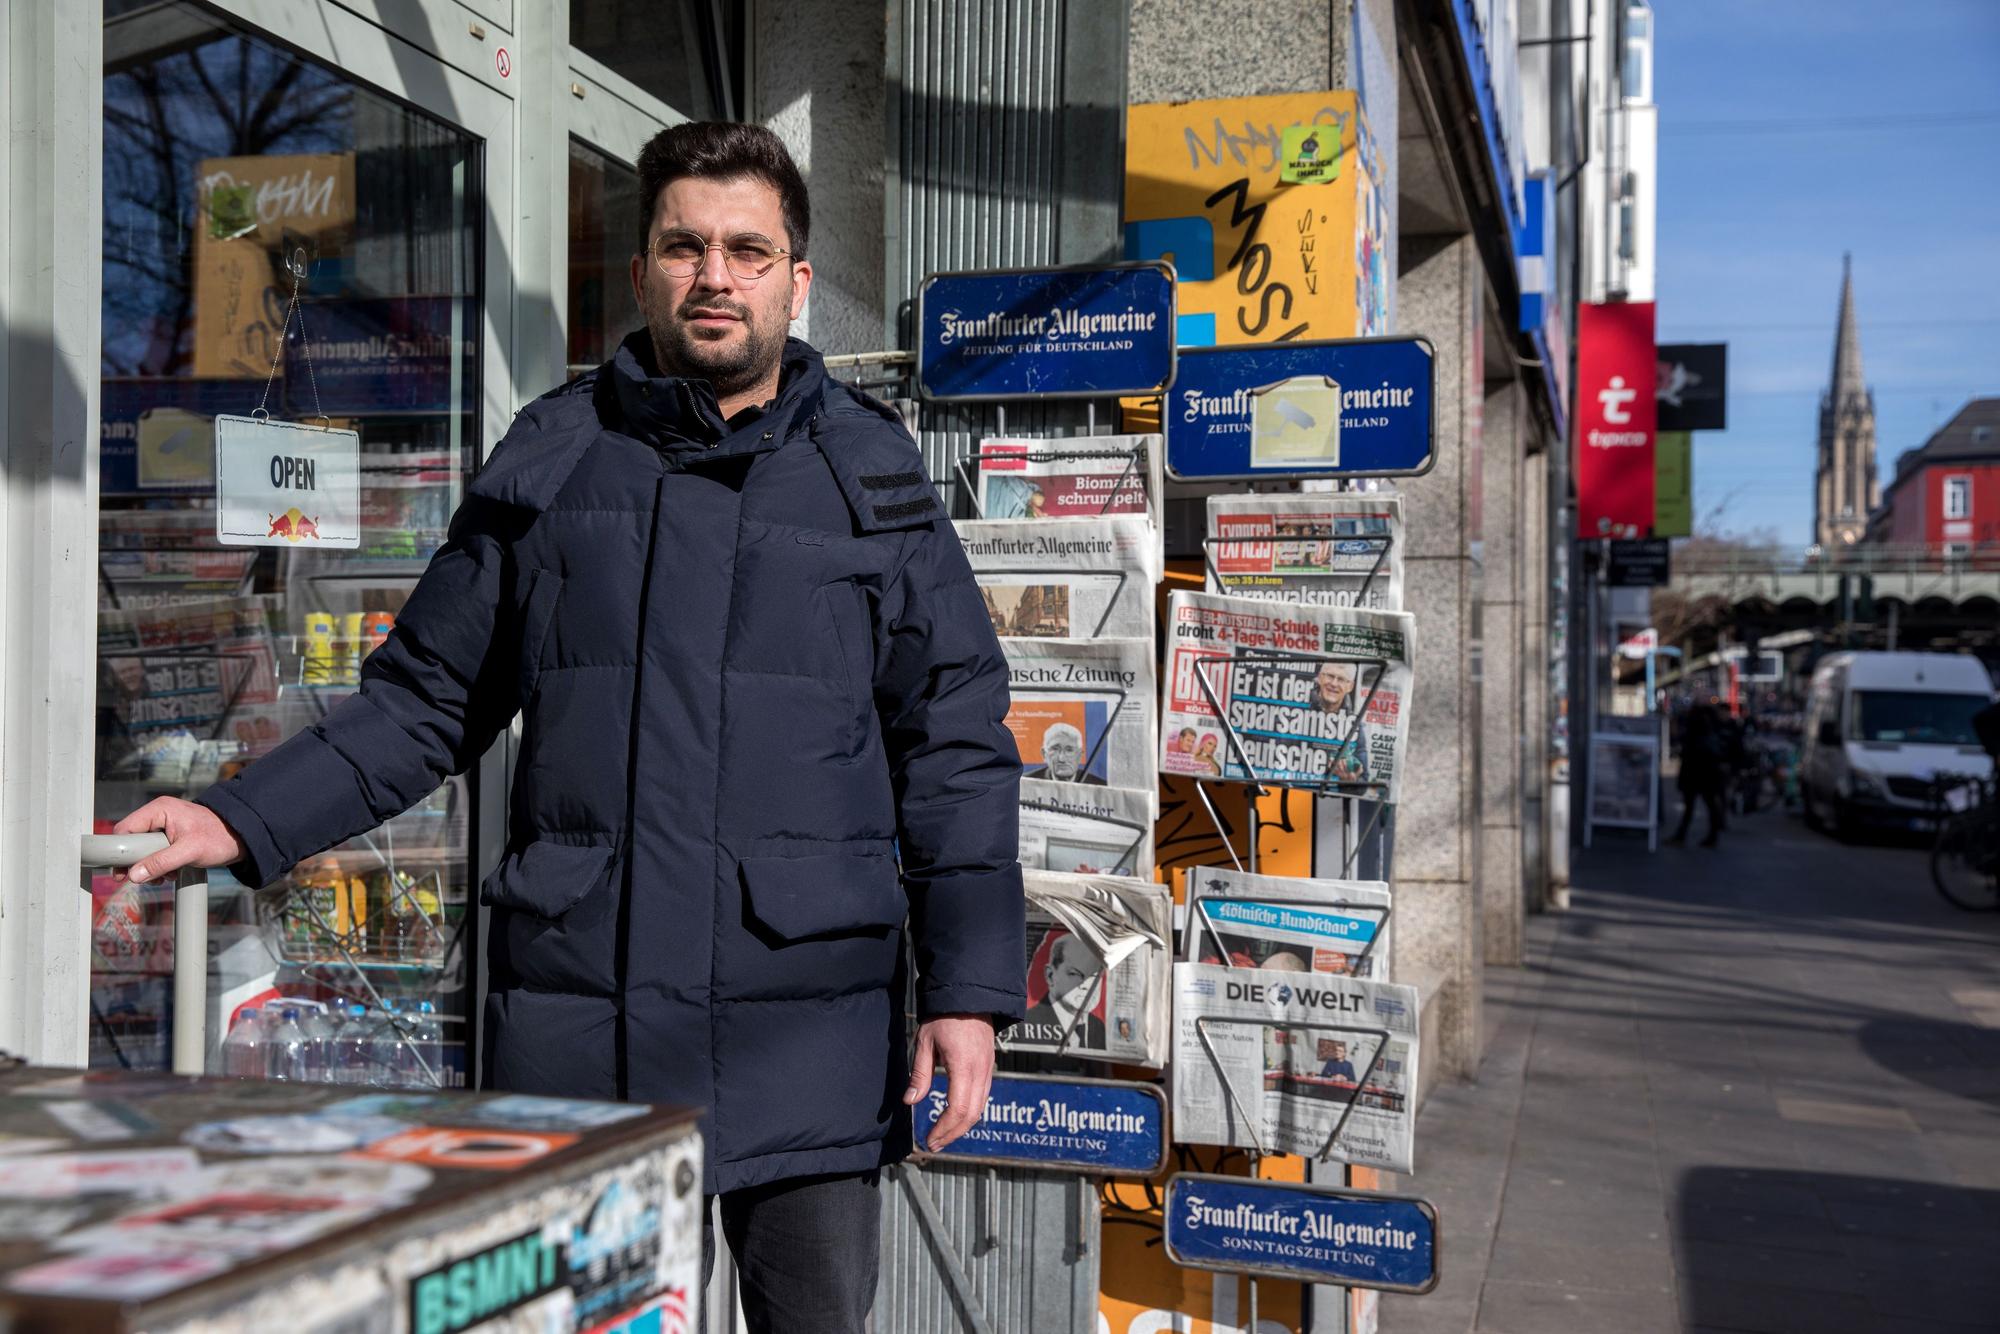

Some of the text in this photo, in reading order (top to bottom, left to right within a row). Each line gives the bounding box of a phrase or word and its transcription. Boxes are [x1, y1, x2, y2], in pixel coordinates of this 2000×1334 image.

[940, 306, 1156, 345] Frankfurter Allgemeine
[963, 340, 1133, 356] ZEITUNG FÜR DEUTSCHLAND
[1184, 388, 1252, 423] Frankf
[1207, 424, 1251, 435] ZEITUN
[271, 455, 315, 491] OPEN
[1037, 536, 1113, 558] Allgemeine
[1177, 622, 1215, 640] droht
[1217, 627, 1320, 651] 4-Tage-Woche
[1273, 619, 1320, 636] Schule
[1009, 663, 1136, 688] utsche Zeitung
[1233, 668, 1315, 703] Er ist der
[1231, 700, 1359, 742] sparsamste
[1280, 912, 1349, 935] Rundschau
[1226, 981, 1265, 1003] DIE
[1024, 1024, 1063, 1041] RISS
[929, 1091, 1145, 1134] Ffurter Allgemeine
[963, 1130, 1107, 1152] SONNTAGSZEITUNG
[1185, 1195, 1417, 1250] Frankfurter Allgemeine
[1222, 1236, 1376, 1267] SONNTAGSZEITUNG
